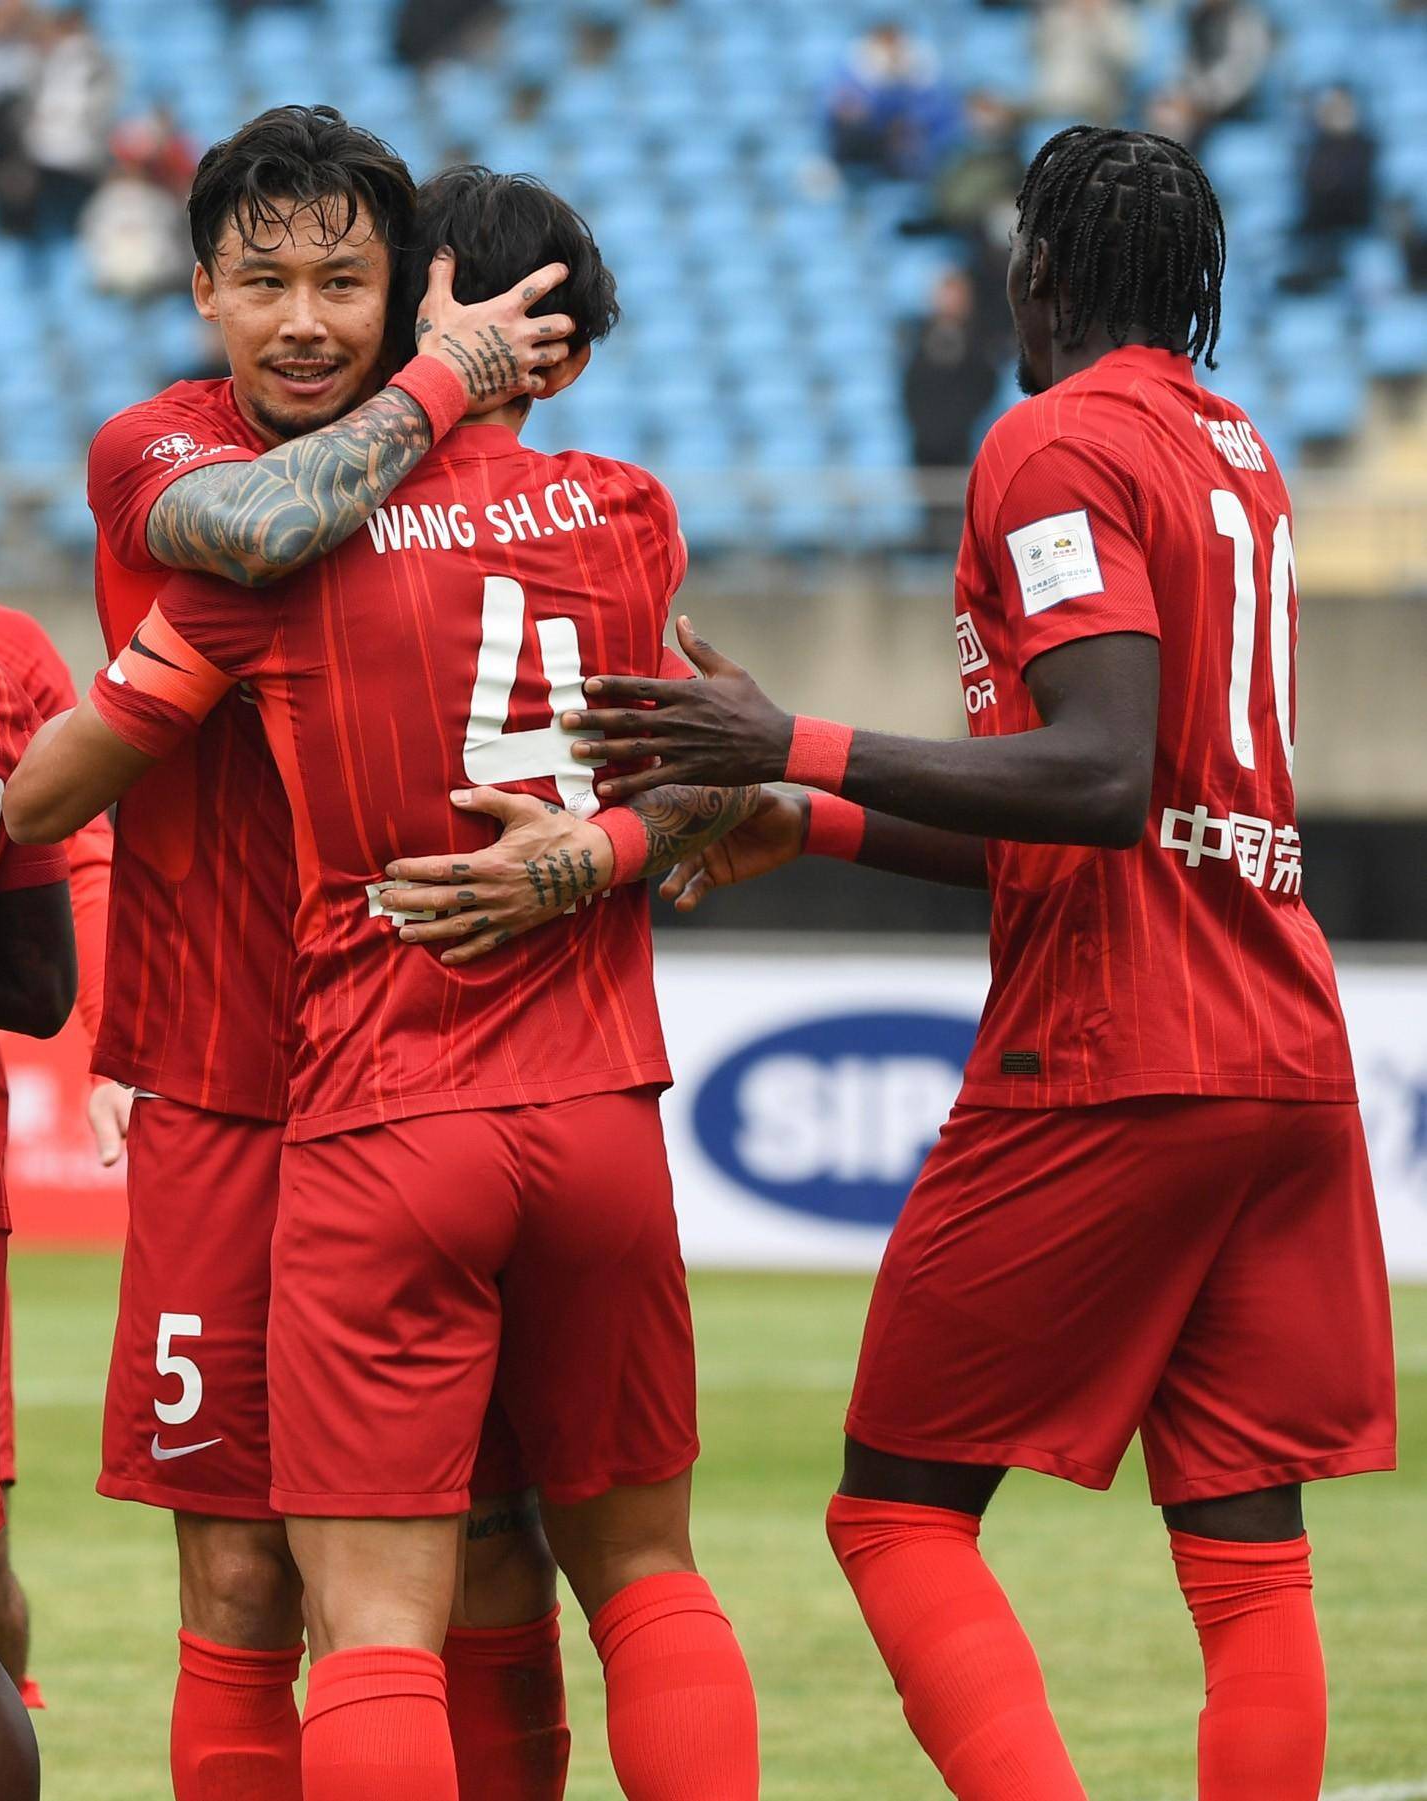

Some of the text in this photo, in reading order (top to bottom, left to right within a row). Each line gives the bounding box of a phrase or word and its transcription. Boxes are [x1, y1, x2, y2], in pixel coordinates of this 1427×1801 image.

[367, 479, 607, 554] WANG SH.CH.
[463, 576, 608, 819] 4
[1210, 489, 1299, 777] 10
[154, 1312, 203, 1424] 5
